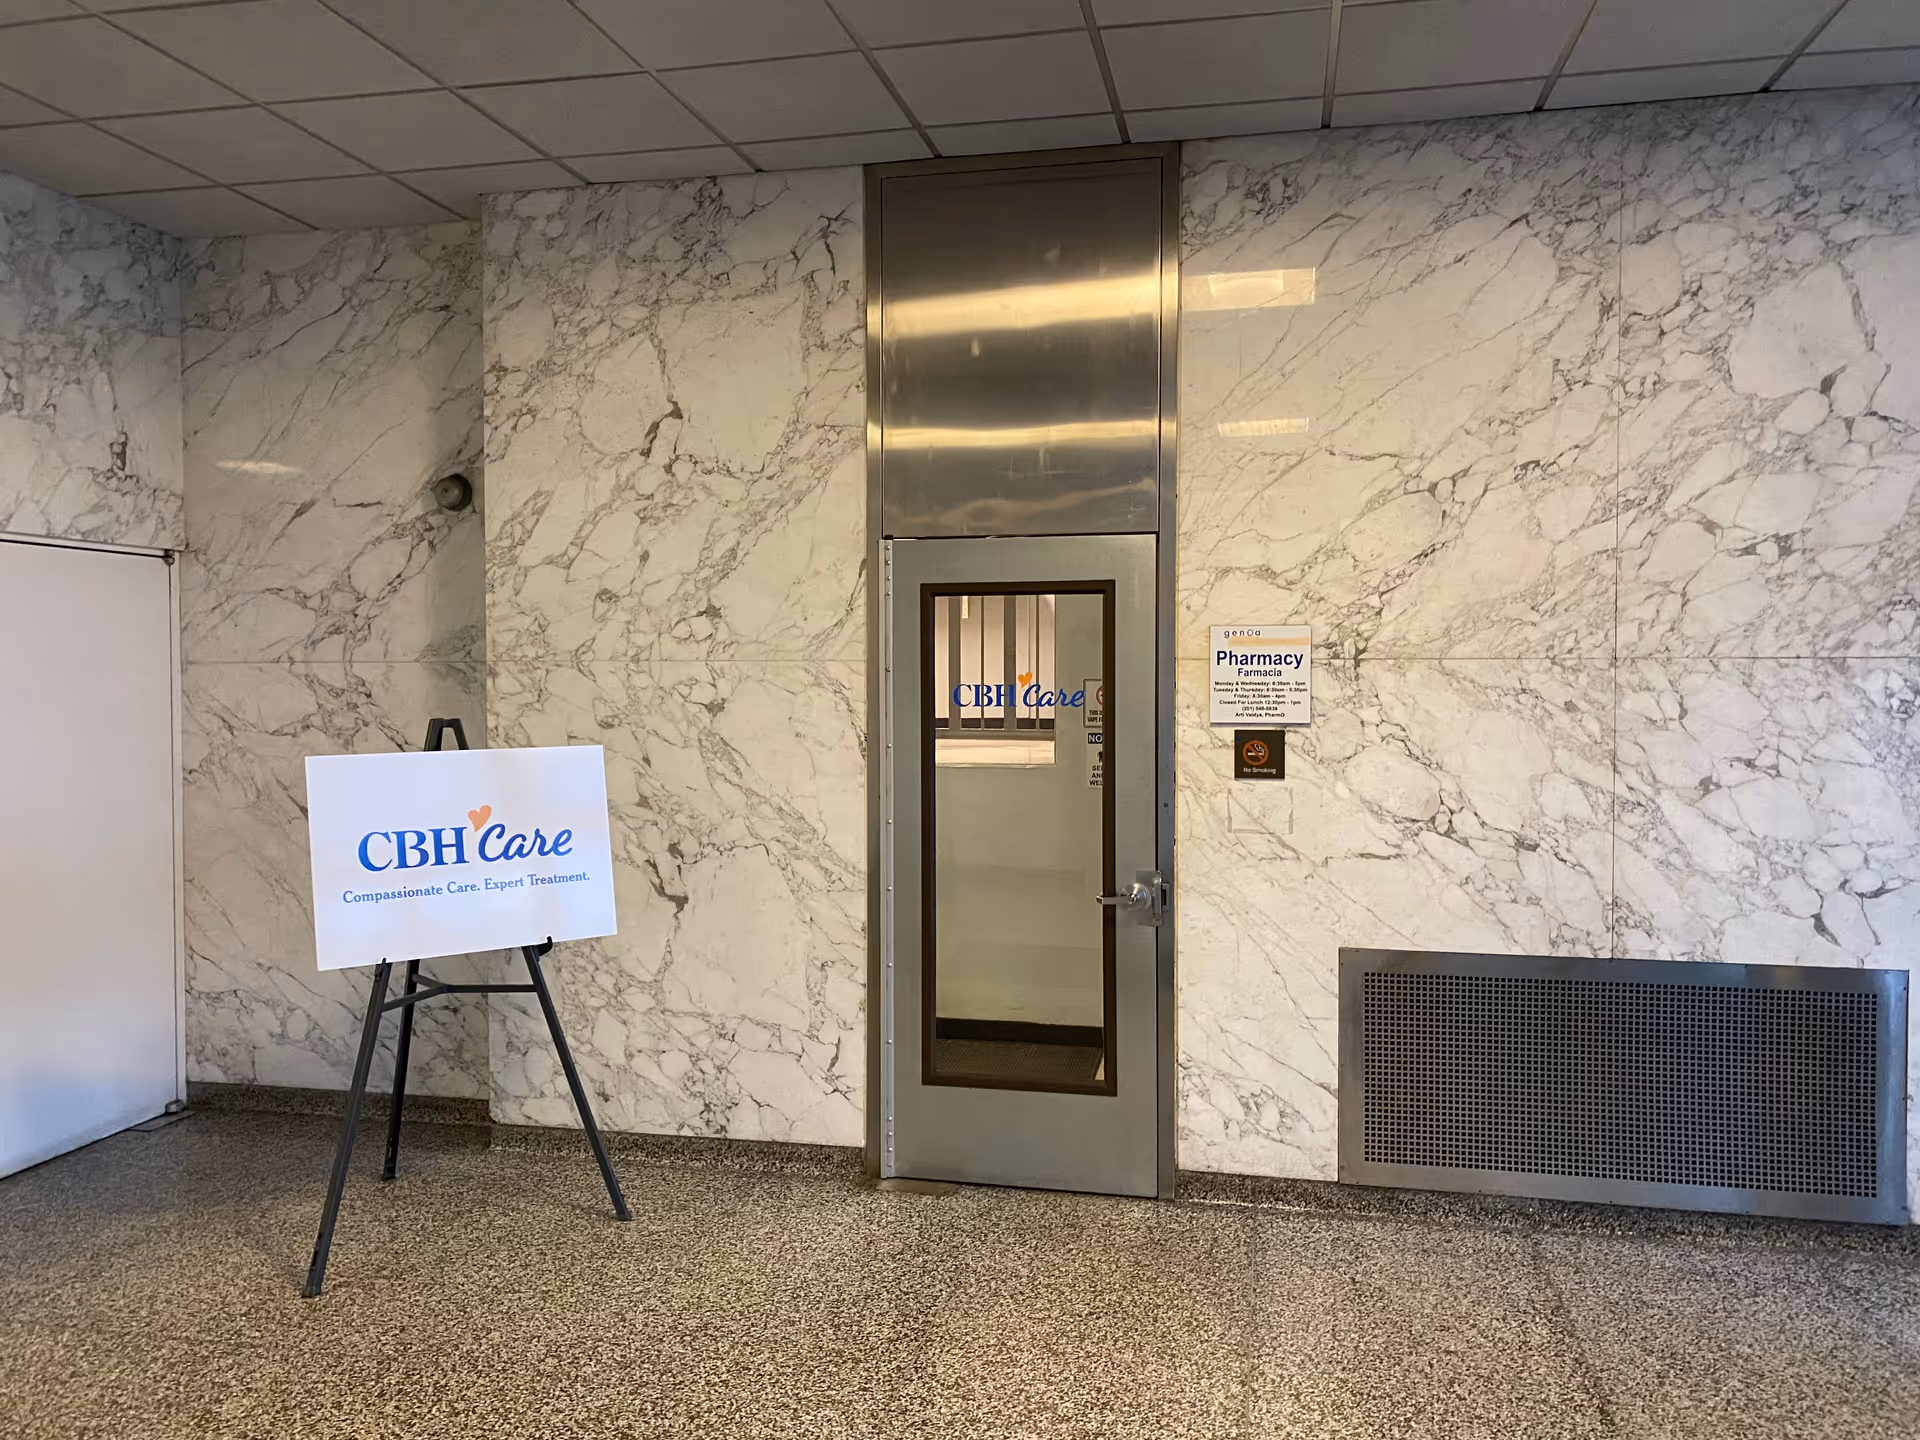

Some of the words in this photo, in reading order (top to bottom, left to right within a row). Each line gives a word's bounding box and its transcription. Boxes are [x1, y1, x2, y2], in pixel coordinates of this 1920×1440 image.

[1216, 650, 1304, 669] Pharmacy
[1237, 667, 1282, 677] Farmacia
[953, 684, 1017, 708] CBH
[1022, 684, 1085, 708] Care
[358, 826, 469, 872] CBH
[478, 823, 572, 862] Care
[342, 884, 443, 904] Compassionate
[447, 880, 481, 894] Care.
[484, 876, 524, 890] Expert
[528, 871, 590, 886] Treatment.
